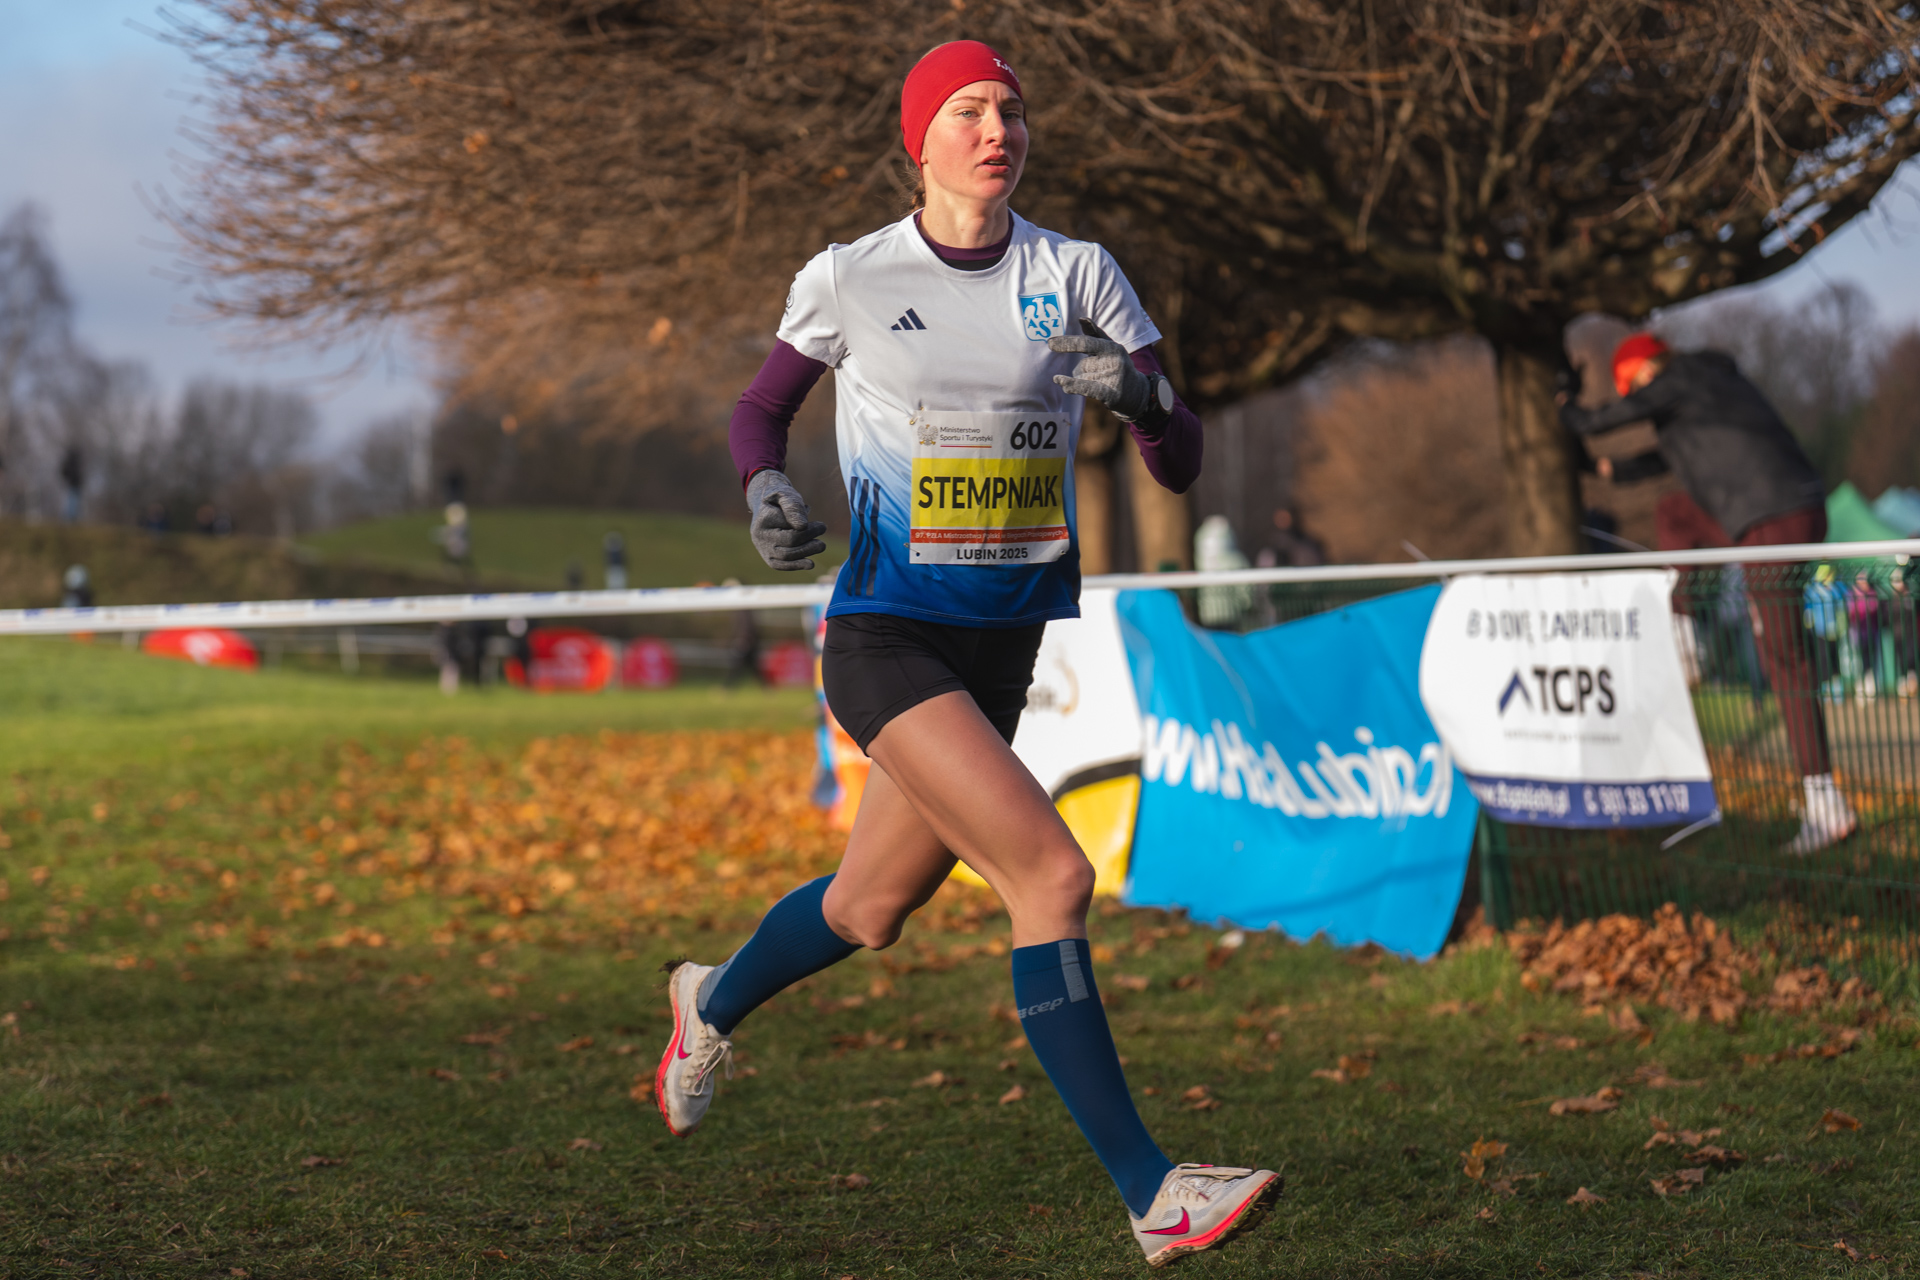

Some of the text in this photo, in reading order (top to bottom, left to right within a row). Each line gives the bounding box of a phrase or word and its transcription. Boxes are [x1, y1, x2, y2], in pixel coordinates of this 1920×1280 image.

[939, 426, 981, 434] Ministerstwo
[939, 434, 961, 442] Sportu
[965, 434, 994, 443] Turystyki
[1010, 421, 1058, 450] 602
[918, 475, 1058, 509] STEMPNIAK
[956, 547, 1029, 560] LUBIN 2025
[1530, 664, 1617, 716] TCPS
[1027, 997, 1065, 1017] cep
